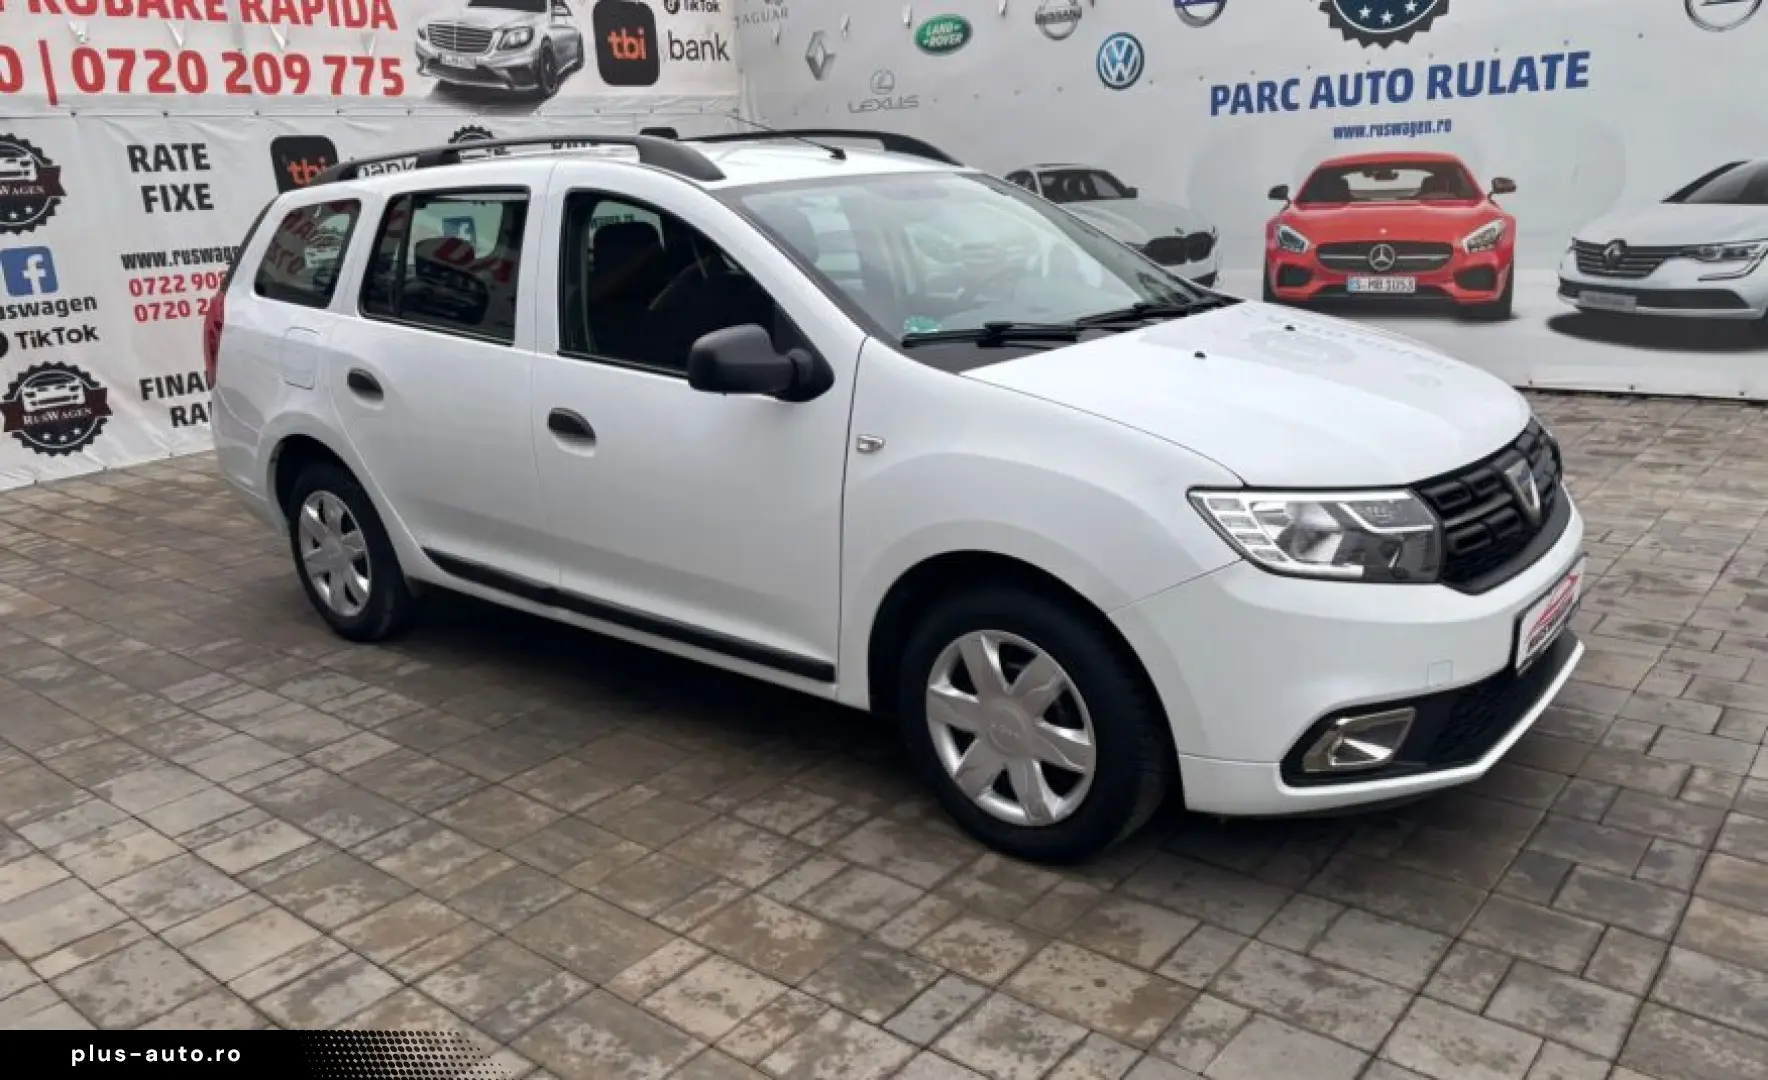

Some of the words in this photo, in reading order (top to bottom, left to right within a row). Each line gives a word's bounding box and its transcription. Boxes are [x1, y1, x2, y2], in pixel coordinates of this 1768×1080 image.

[239, 0, 398, 30] RAPIDA
[608, 28, 647, 60] tbi
[668, 30, 730, 62] bank
[71, 47, 208, 94] 0720
[221, 52, 311, 96] 209
[323, 56, 405, 96] 775
[1211, 79, 1300, 116] PARC
[1309, 68, 1414, 110] AUTO
[1427, 51, 1590, 101] RULATE
[127, 143, 211, 172] RATE
[141, 183, 214, 214] FIXE
[128, 274, 187, 297] 0722
[134, 299, 192, 323] 0720
[14, 325, 99, 350] TikTok
